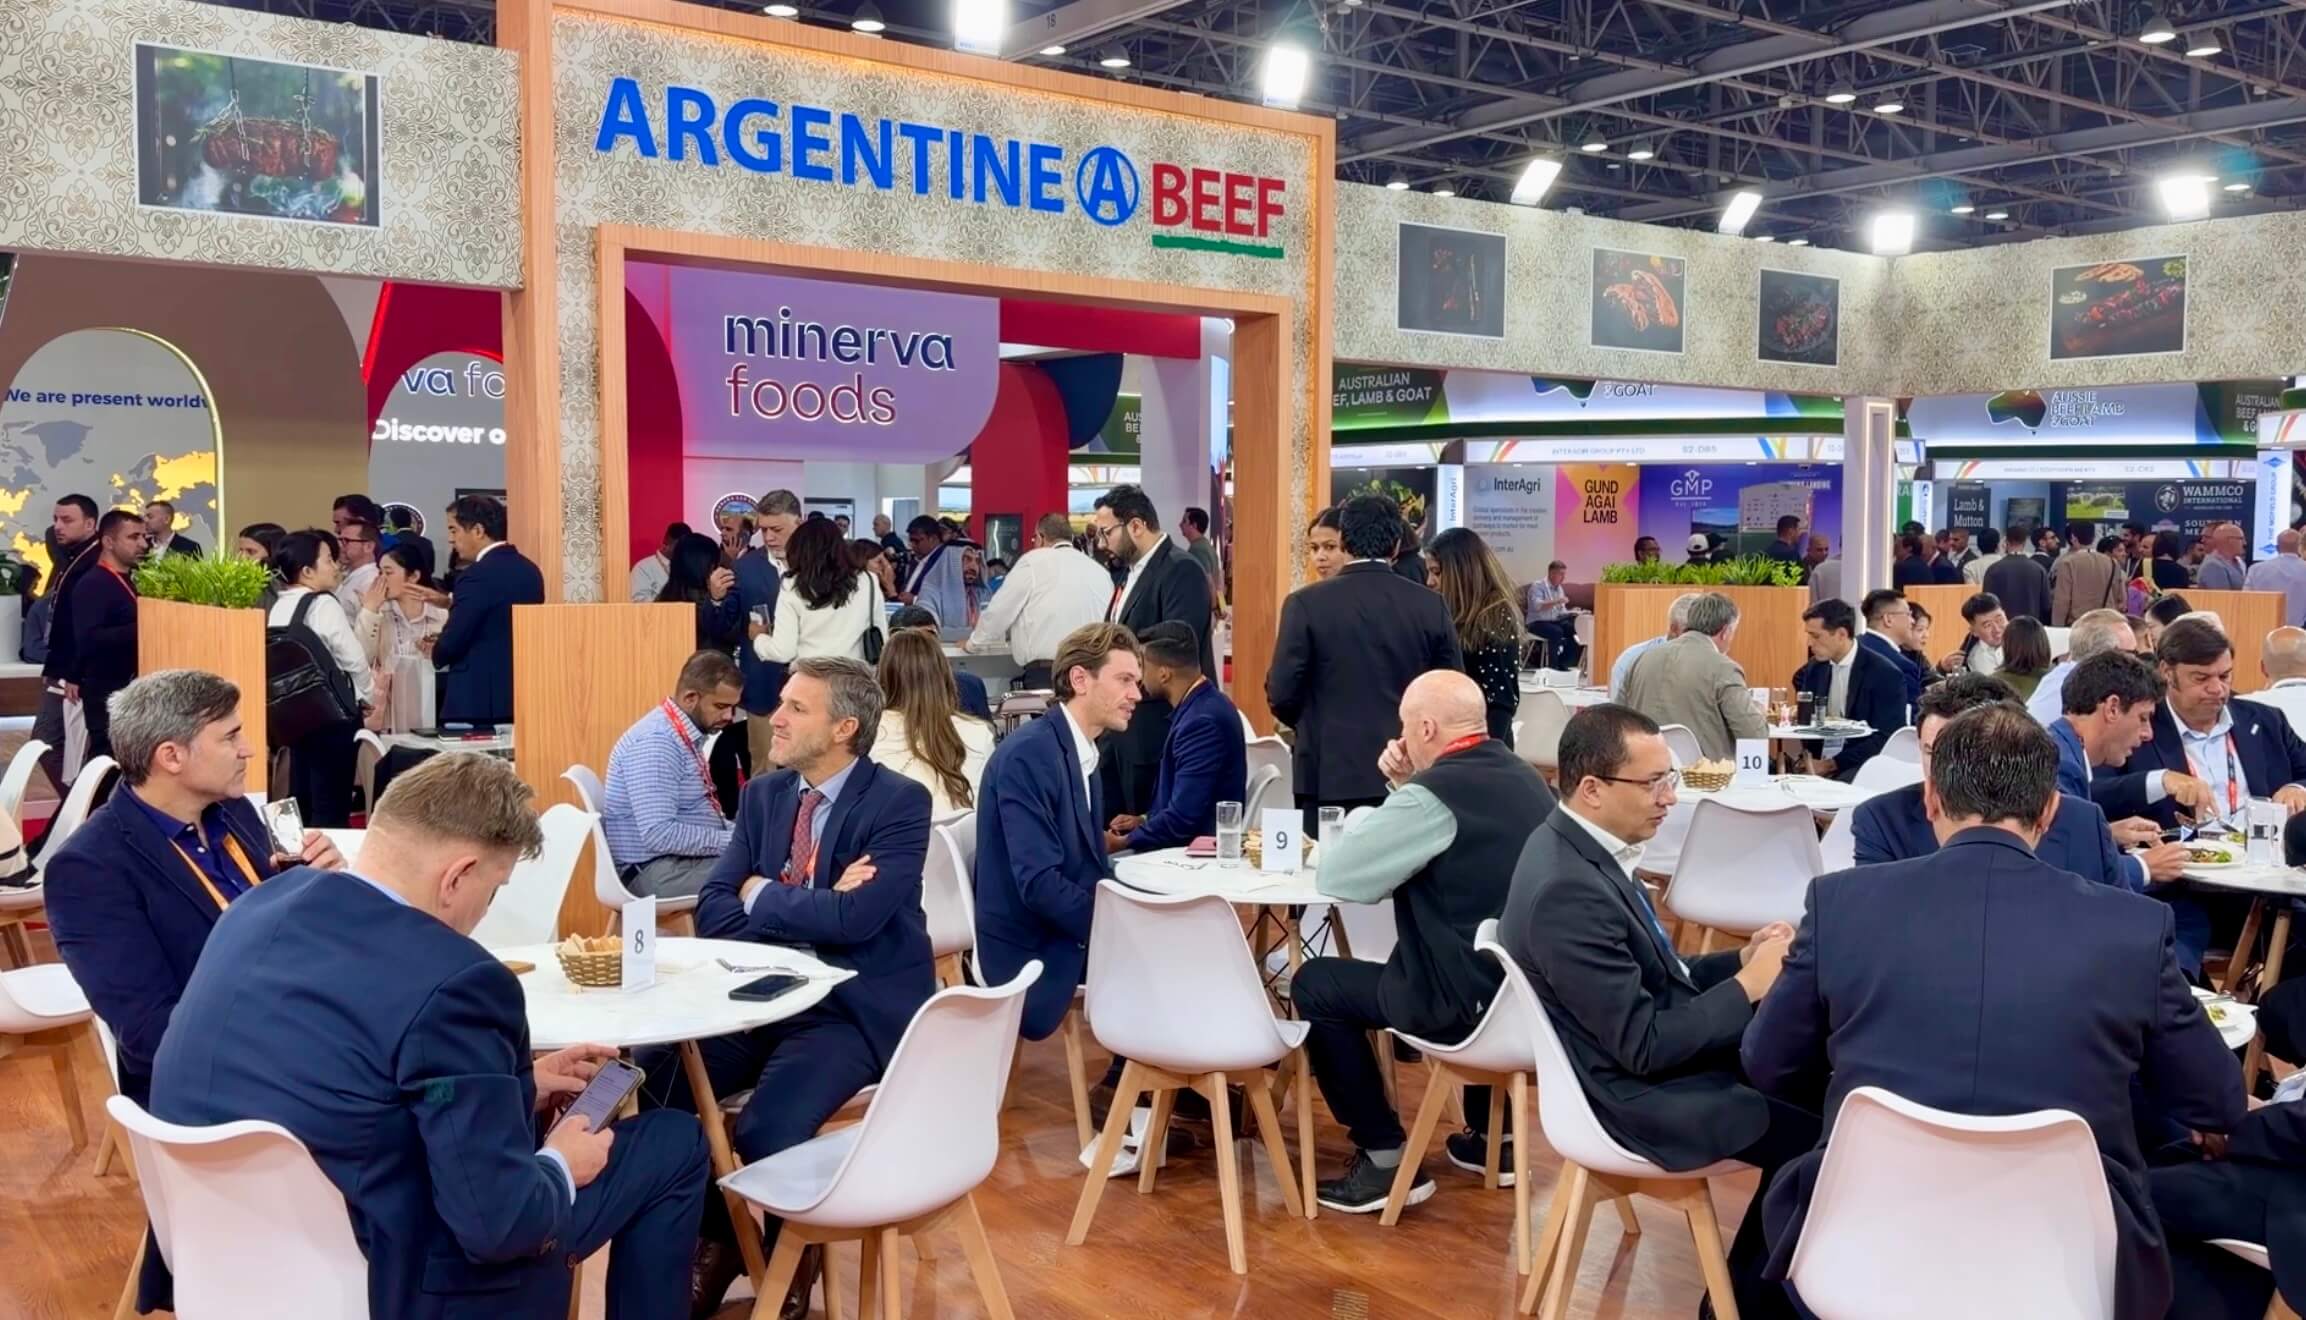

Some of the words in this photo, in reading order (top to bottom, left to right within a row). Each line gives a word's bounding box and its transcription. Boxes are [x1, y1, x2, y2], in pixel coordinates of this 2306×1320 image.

[595, 76, 1065, 212] ARGENTINE
[1152, 163, 1286, 238] BEEF
[724, 306, 956, 371] minerva
[1338, 371, 1411, 390] AUSTRALIAN
[36, 391, 67, 403] are
[72, 392, 143, 407] present
[726, 362, 896, 425] foods
[1351, 389, 1384, 406] LAMB
[1385, 388, 1395, 403] &
[1396, 386, 1432, 402] GOAT
[372, 418, 485, 444] Discover
[1494, 476, 1541, 495] InterAgri
[1584, 479, 1619, 494] GUND
[1670, 479, 1713, 496] GMP
[2183, 485, 2244, 497] WAMMCO
[1585, 495, 1616, 508] AGAI
[1953, 498, 1977, 511] Lamb
[1978, 499, 1985, 511] &
[1583, 510, 1618, 523] LAMB
[1953, 514, 1984, 528] Mutton
[1742, 755, 1762, 770] 10
[1275, 831, 1288, 849] 9
[634, 928, 645, 954] 8
